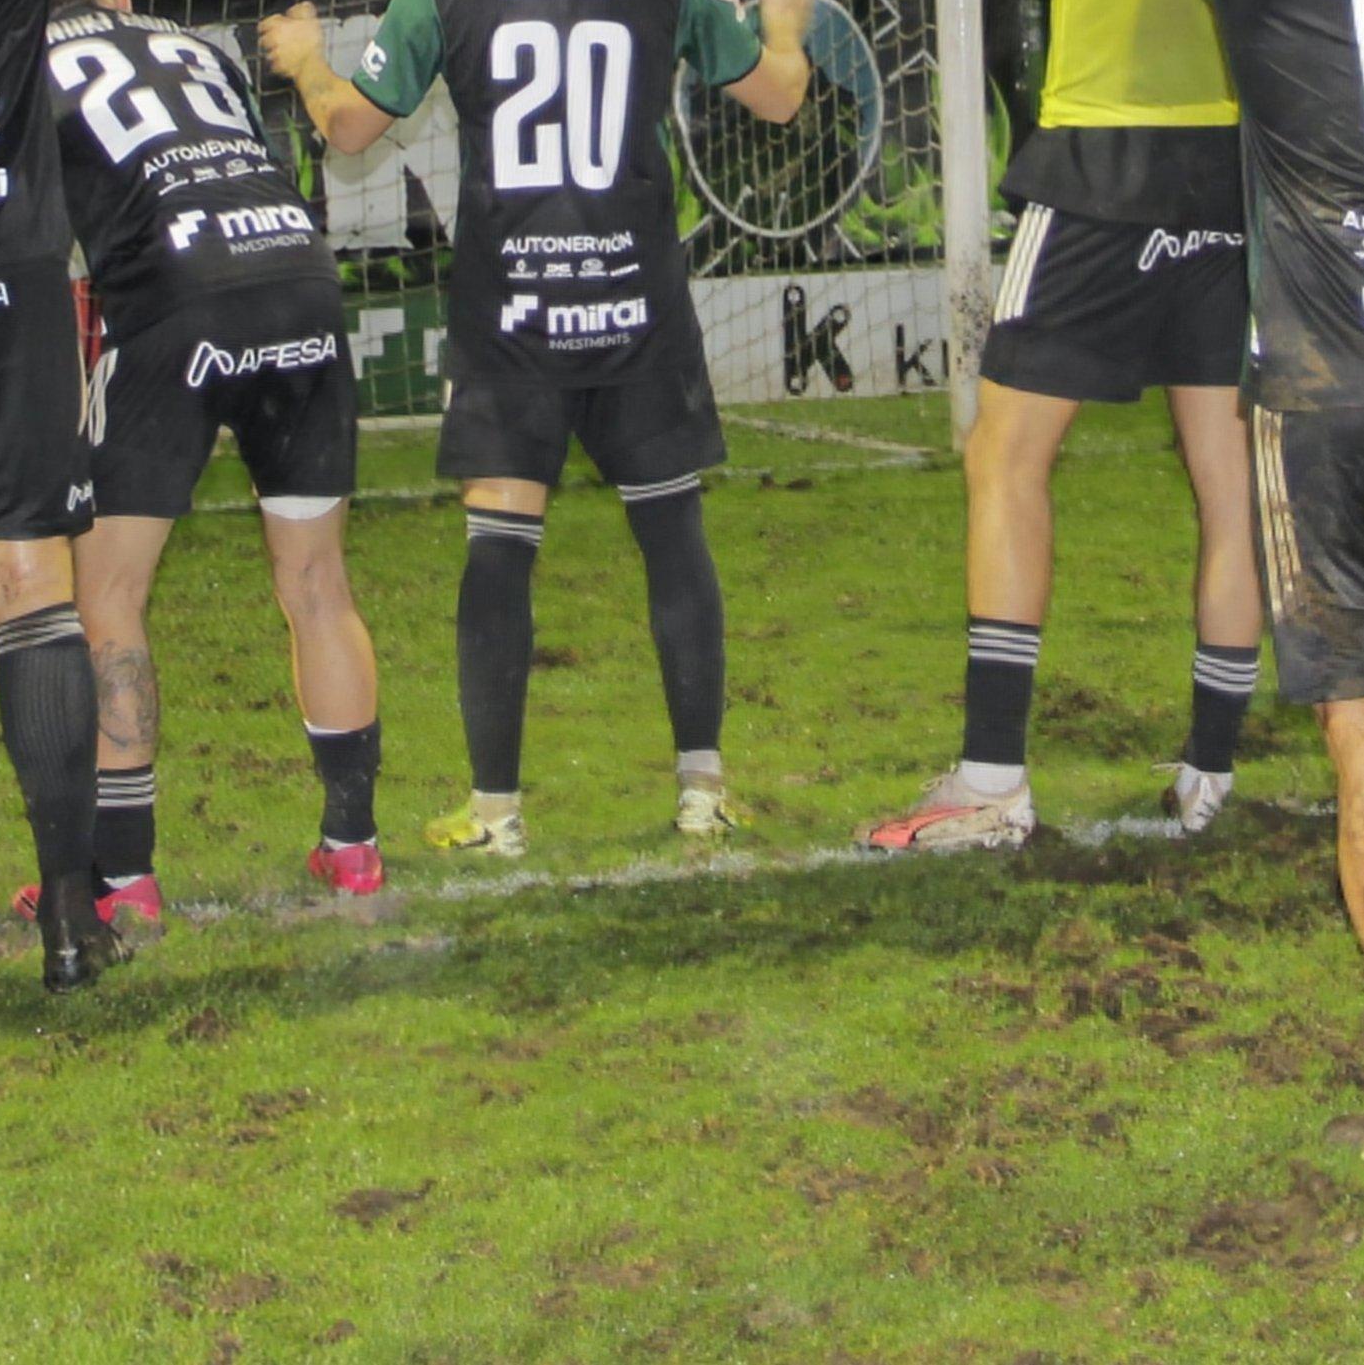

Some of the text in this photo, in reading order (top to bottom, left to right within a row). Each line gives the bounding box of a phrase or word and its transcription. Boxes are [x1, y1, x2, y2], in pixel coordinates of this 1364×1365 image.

[48, 33, 255, 165] 23
[491, 19, 632, 190] 20
[216, 203, 314, 238] mira
[501, 230, 634, 255] AUTONERVIÓN
[547, 297, 647, 334] mirai
[236, 334, 337, 375] AFESA
[548, 333, 631, 350] INVESTMENTS
